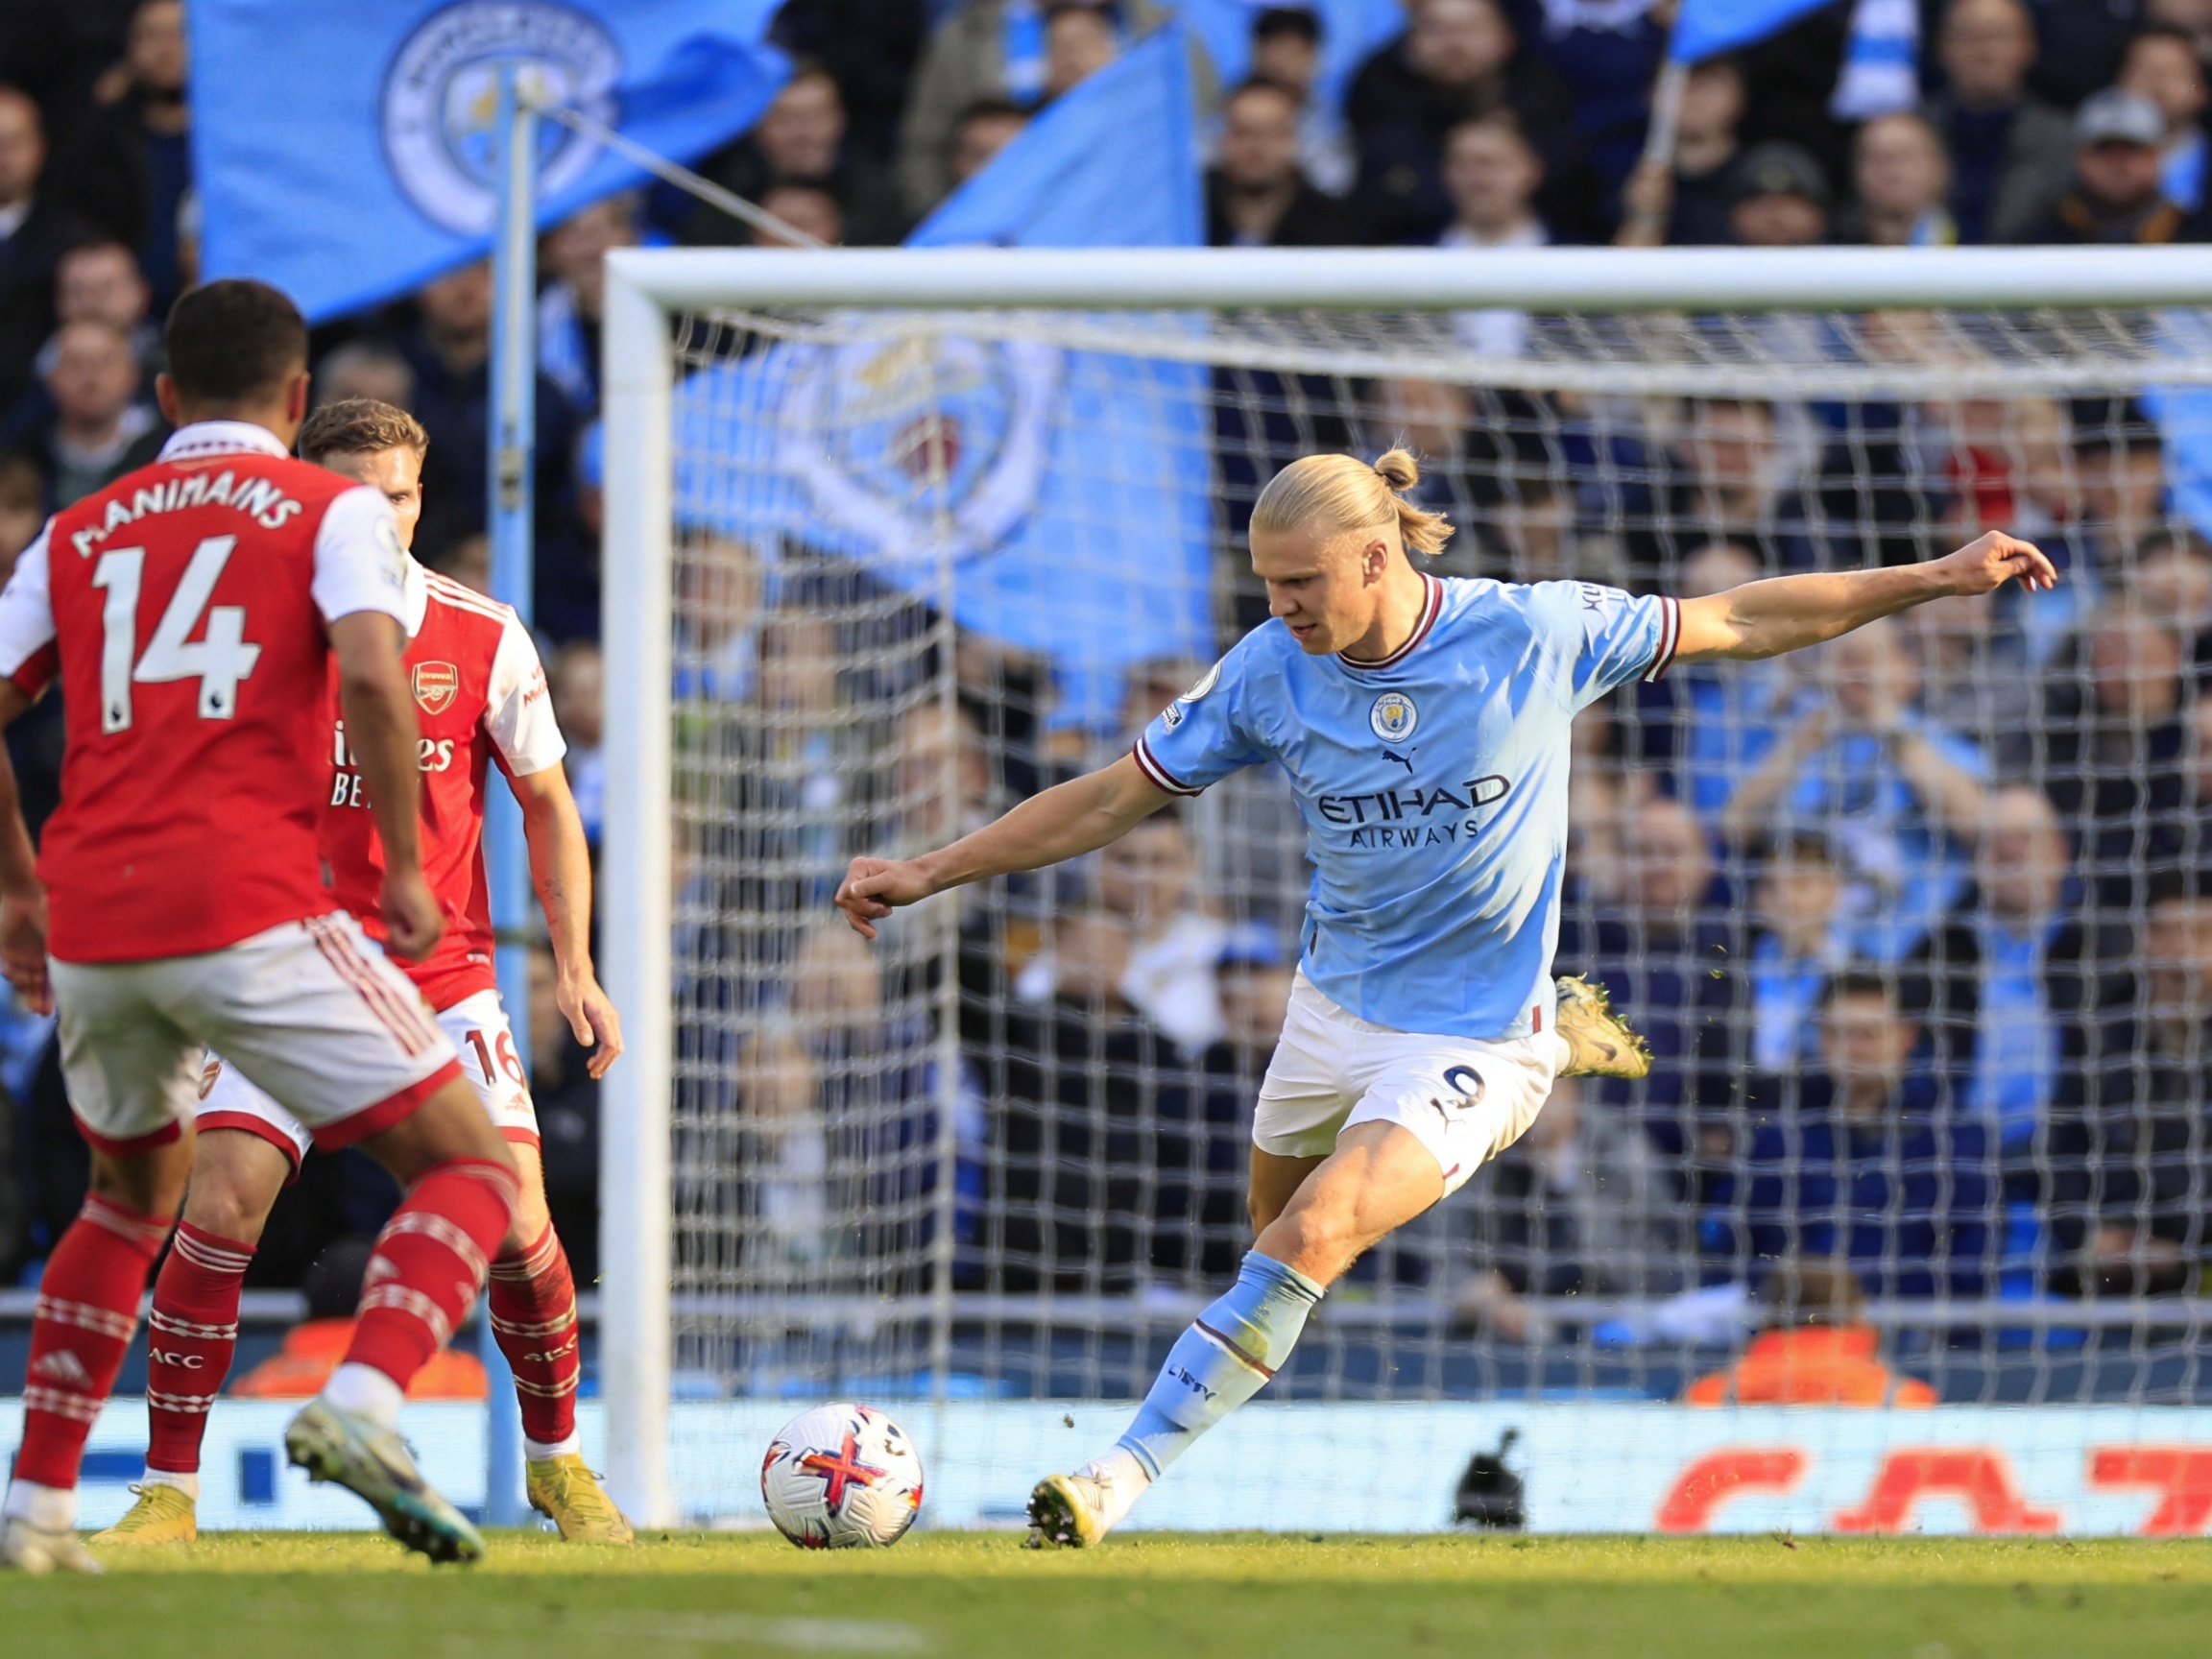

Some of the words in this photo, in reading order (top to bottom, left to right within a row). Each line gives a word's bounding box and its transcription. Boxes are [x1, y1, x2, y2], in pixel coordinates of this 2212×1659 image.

[91, 533, 262, 735] 14
[1318, 774, 1511, 824] ETIHAD
[1350, 820, 1479, 849] AIRWAYS
[465, 1029, 526, 1088] 16
[1443, 1064, 1486, 1110] 9
